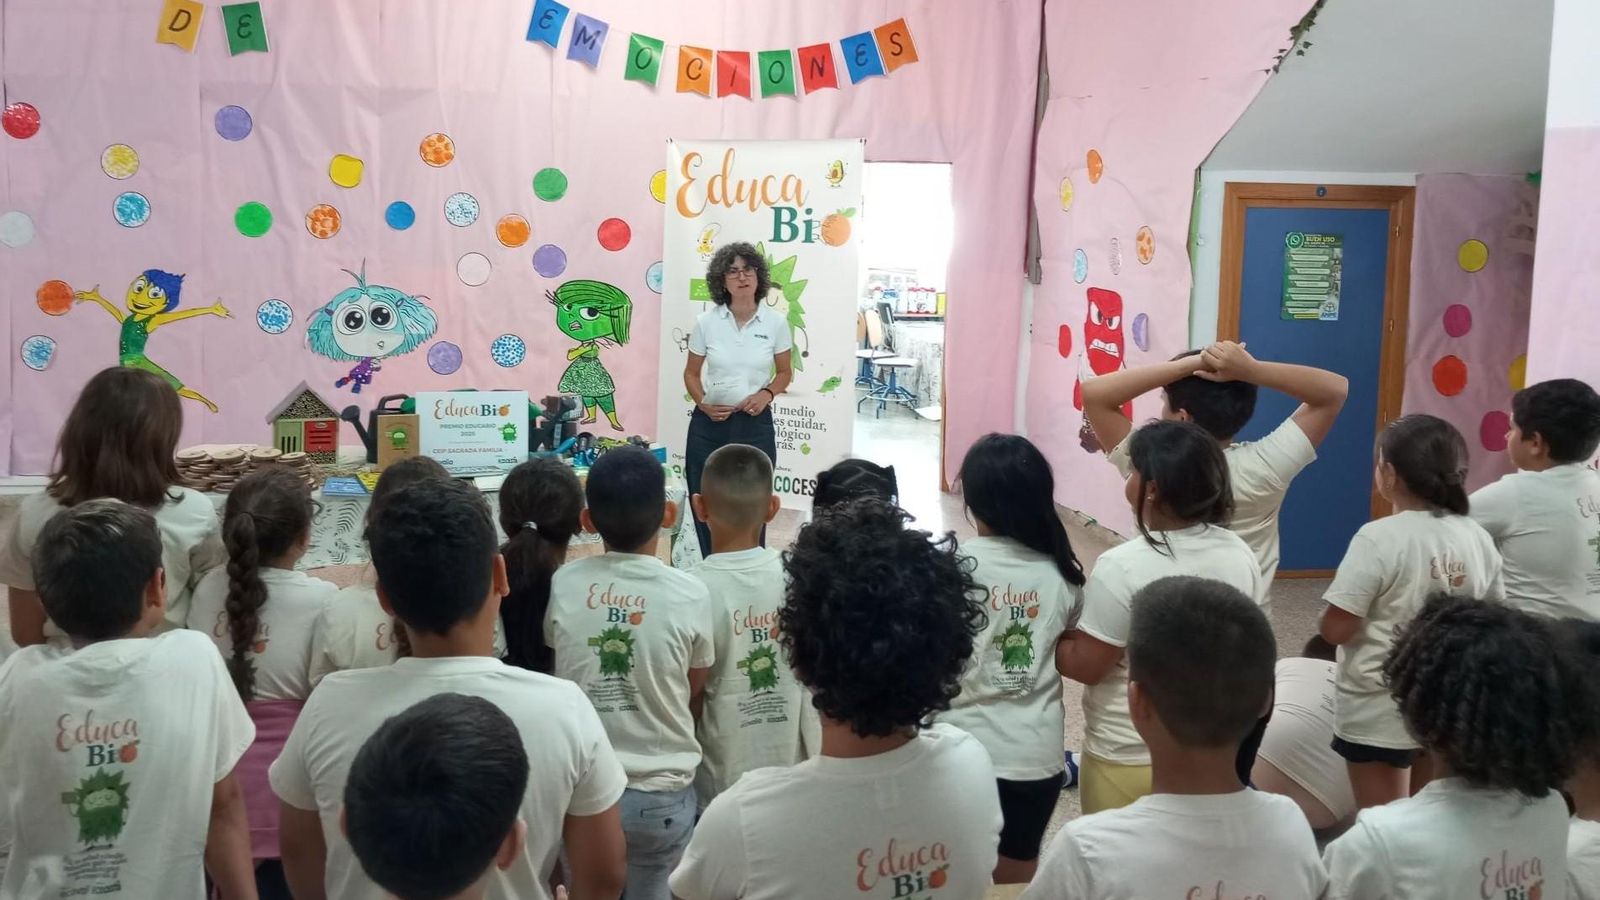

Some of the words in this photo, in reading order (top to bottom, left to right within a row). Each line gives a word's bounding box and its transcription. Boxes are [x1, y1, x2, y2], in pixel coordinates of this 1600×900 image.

[168, 9, 252, 39] DE
[538, 8, 903, 87] EMOCIONES
[676, 147, 810, 219] Educa
[773, 417, 785, 426] es
[787, 418, 827, 432] cuidar,
[780, 405, 816, 418] medio
[776, 438, 796, 451] rás.
[777, 426, 811, 442] lógico
[774, 475, 817, 497] COCES
[586, 582, 646, 610] Educa
[991, 582, 1040, 611] Educa
[56, 709, 139, 752] Educa
[857, 837, 951, 892] Educa
[1481, 849, 1542, 900] Educa
